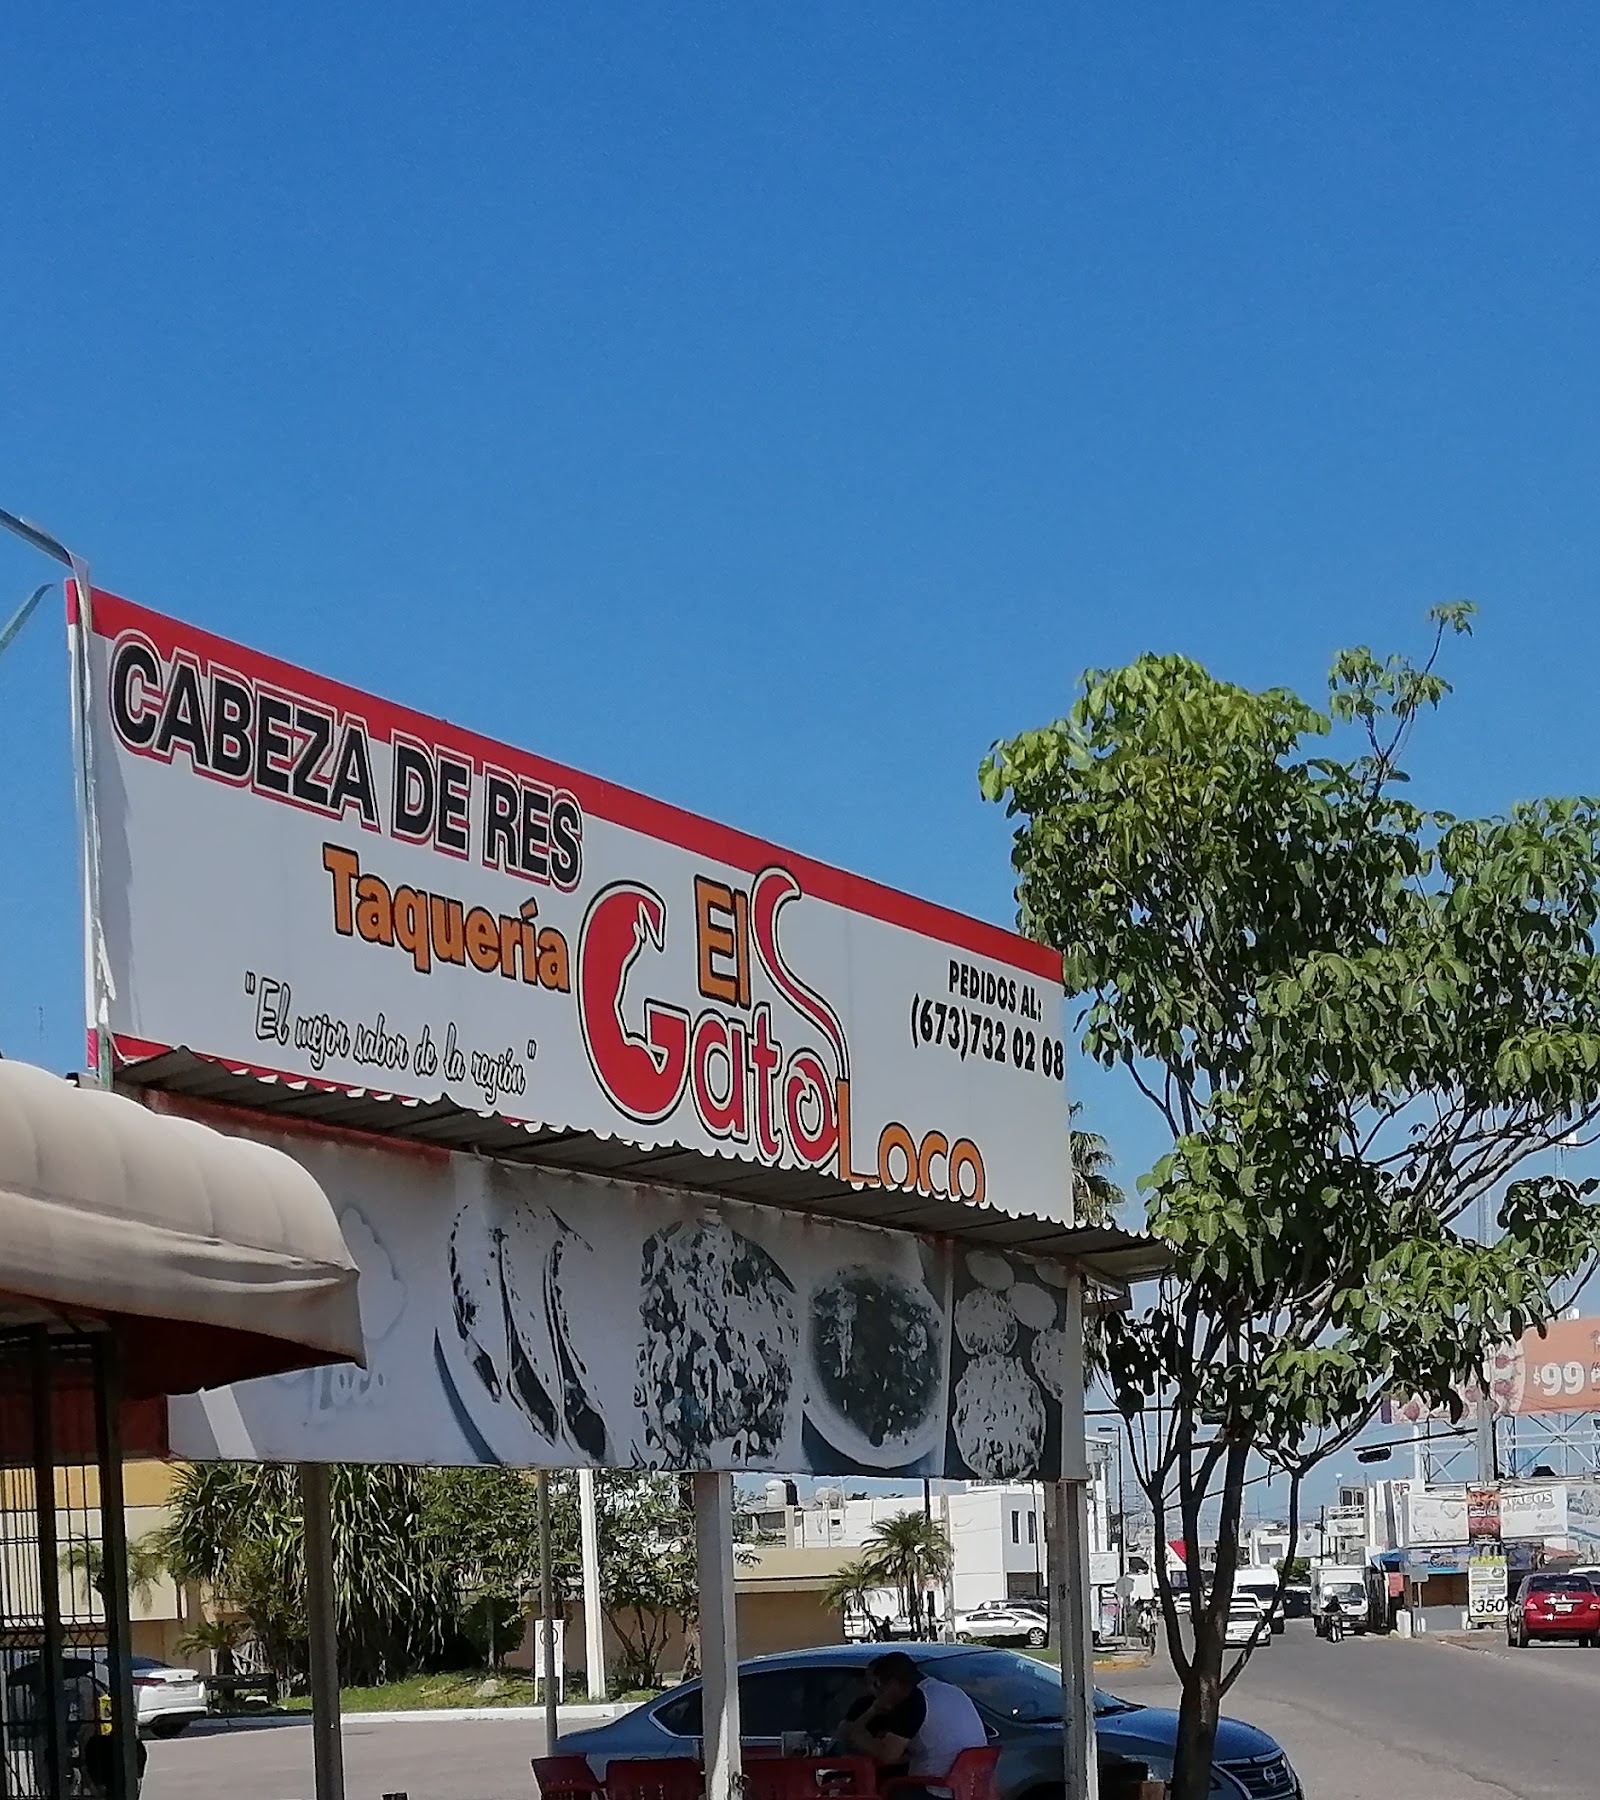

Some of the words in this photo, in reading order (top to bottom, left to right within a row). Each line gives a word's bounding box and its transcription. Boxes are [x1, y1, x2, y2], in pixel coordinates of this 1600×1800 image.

[112, 632, 381, 832] CABEZA
[391, 730, 473, 858] DE
[483, 764, 583, 892] RES
[322, 842, 571, 993] Taquería
[694, 874, 751, 1010] El
[948, 959, 1017, 1012] PEDIDOS
[1020, 984, 1042, 1022] AL:
[294, 1013, 350, 1071] mejor
[352, 1012, 409, 1071] sabor
[413, 1024, 438, 1076] de
[443, 1021, 466, 1081] la
[911, 993, 1006, 1063] (673)732
[1012, 1026, 1036, 1072] 02
[1041, 1036, 1065, 1081] 08
[1533, 1361, 1585, 1396] $99
